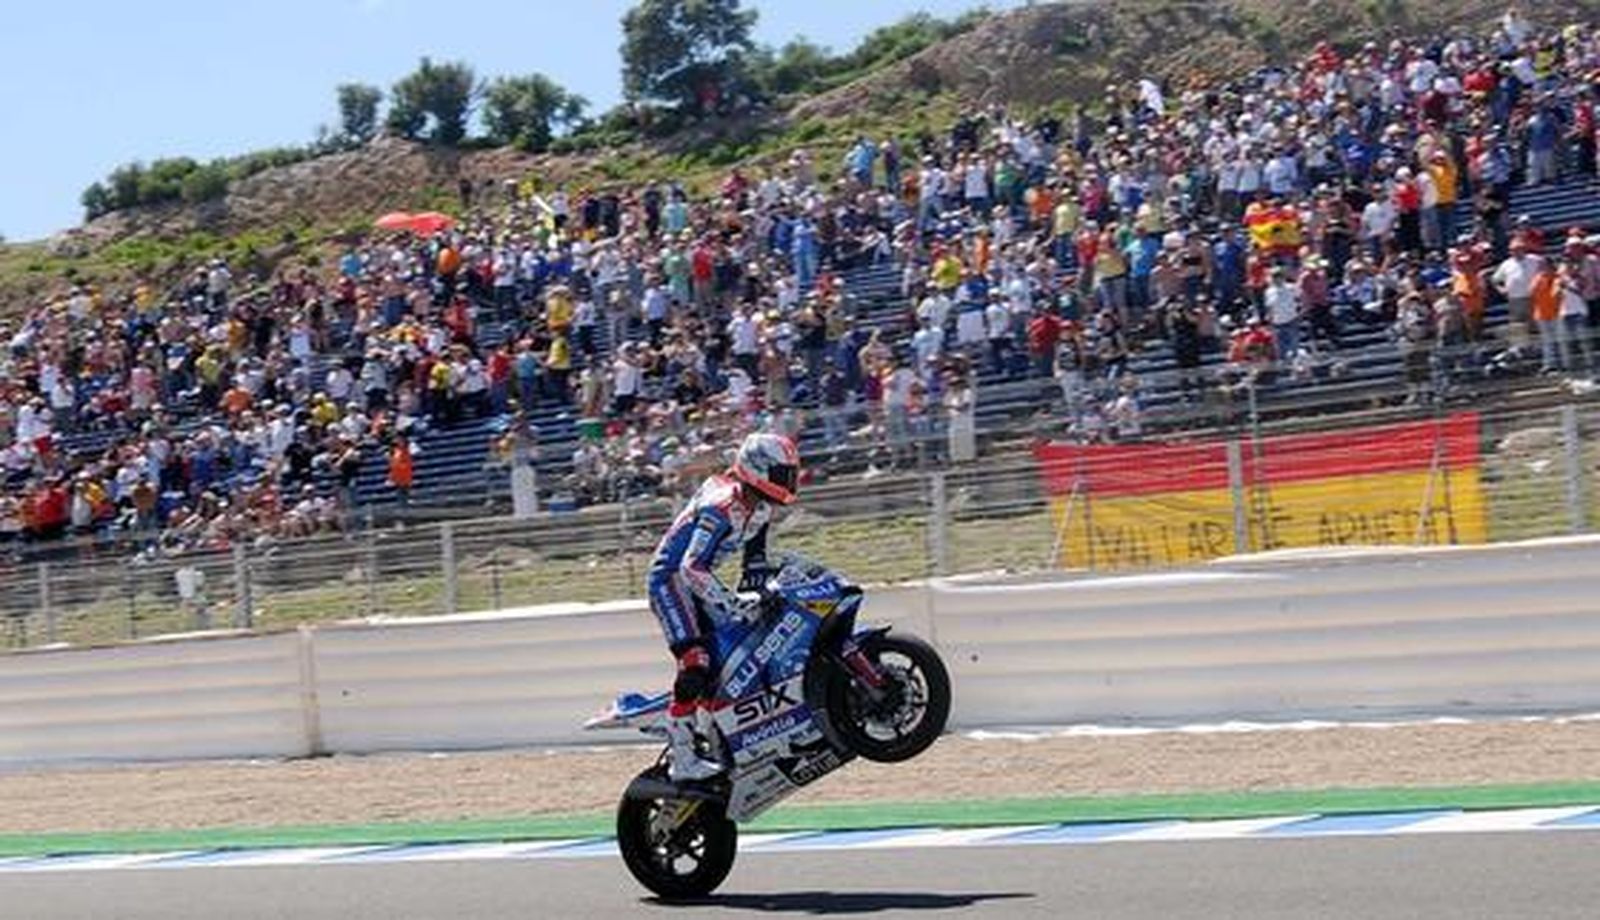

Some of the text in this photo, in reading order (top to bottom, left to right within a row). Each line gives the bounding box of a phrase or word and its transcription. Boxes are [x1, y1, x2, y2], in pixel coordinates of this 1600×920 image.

[725, 610, 802, 698] BLU SENS
[733, 683, 797, 725] STX
